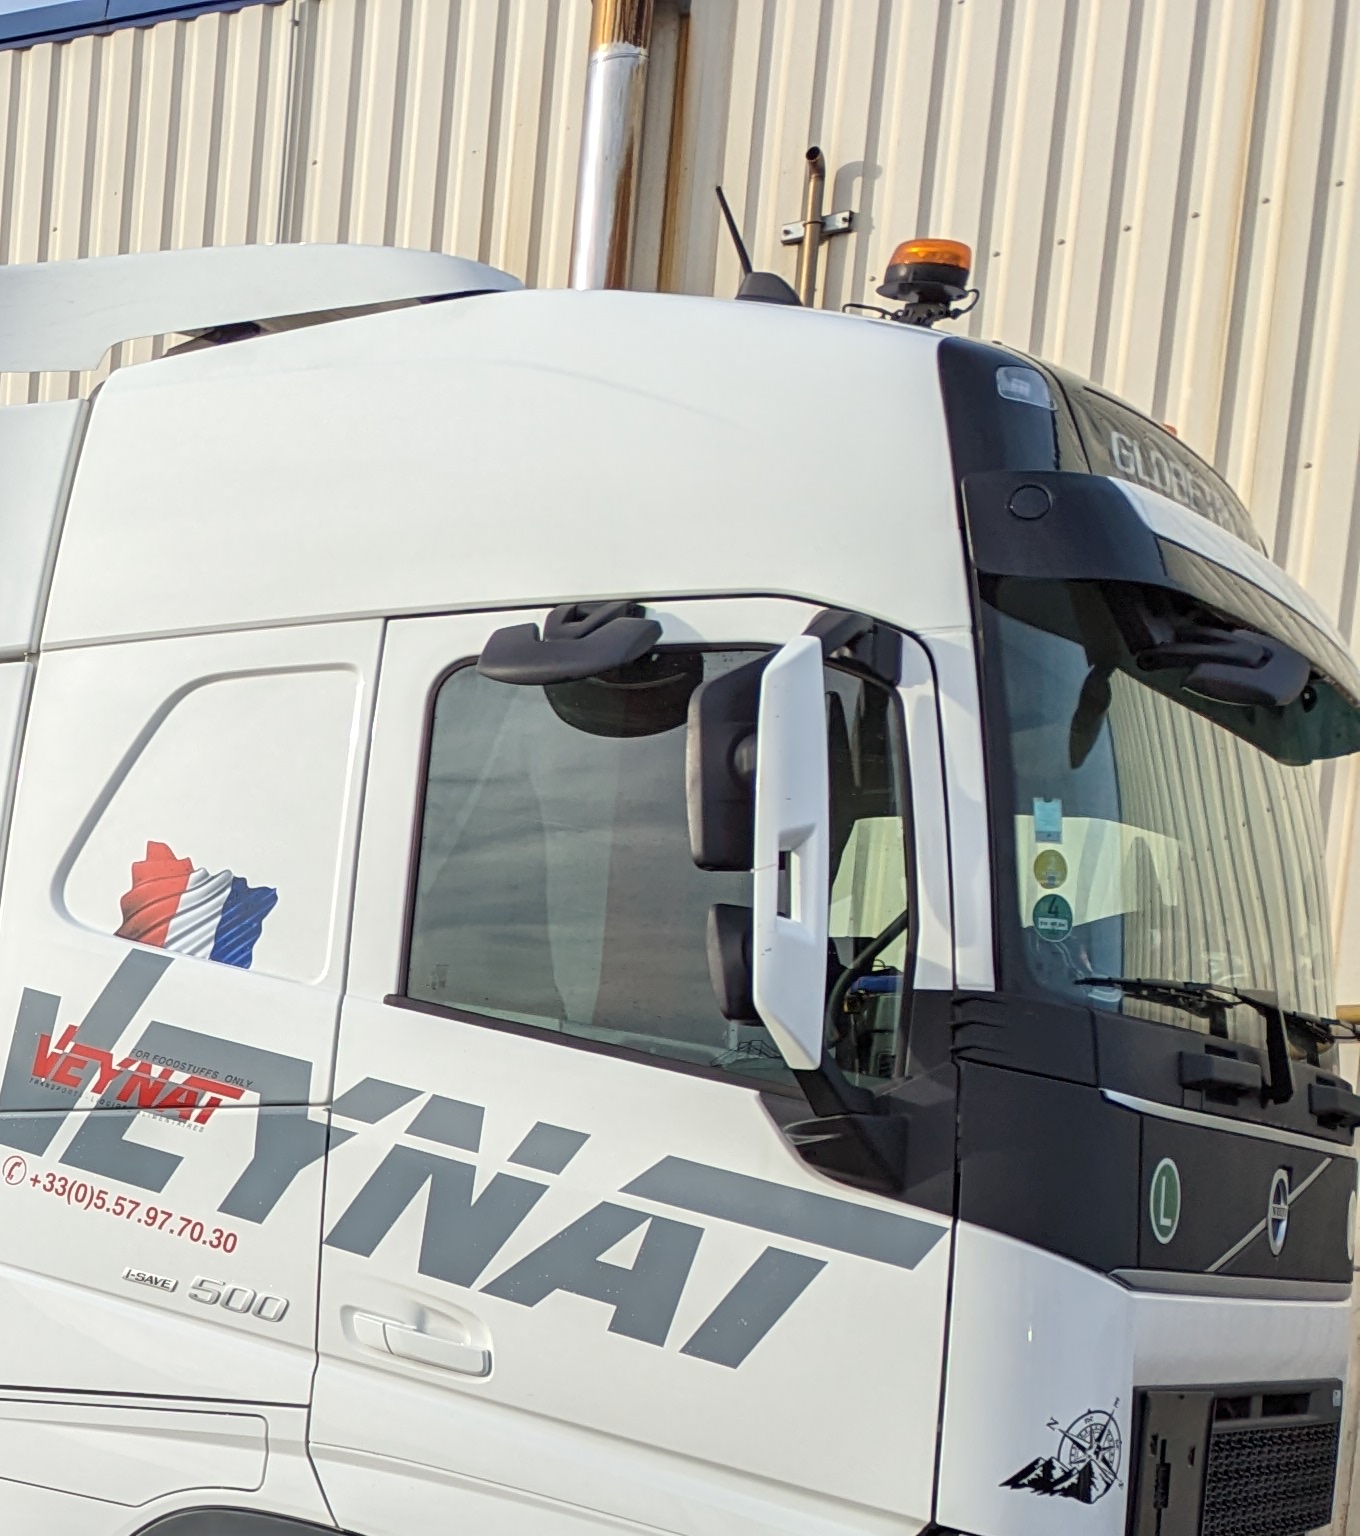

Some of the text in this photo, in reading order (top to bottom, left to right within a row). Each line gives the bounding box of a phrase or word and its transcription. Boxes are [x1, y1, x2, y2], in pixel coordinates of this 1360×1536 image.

[31, 1023, 246, 1126] VEYNAT
[130, 1048, 254, 1089] FOR FOODSTUFFS ONLY
[29, 1172, 239, 1254] +33(0)5.57.97.70.30
[1159, 1175, 1172, 1227] L
[125, 1268, 290, 1323] I-SAVE 500
